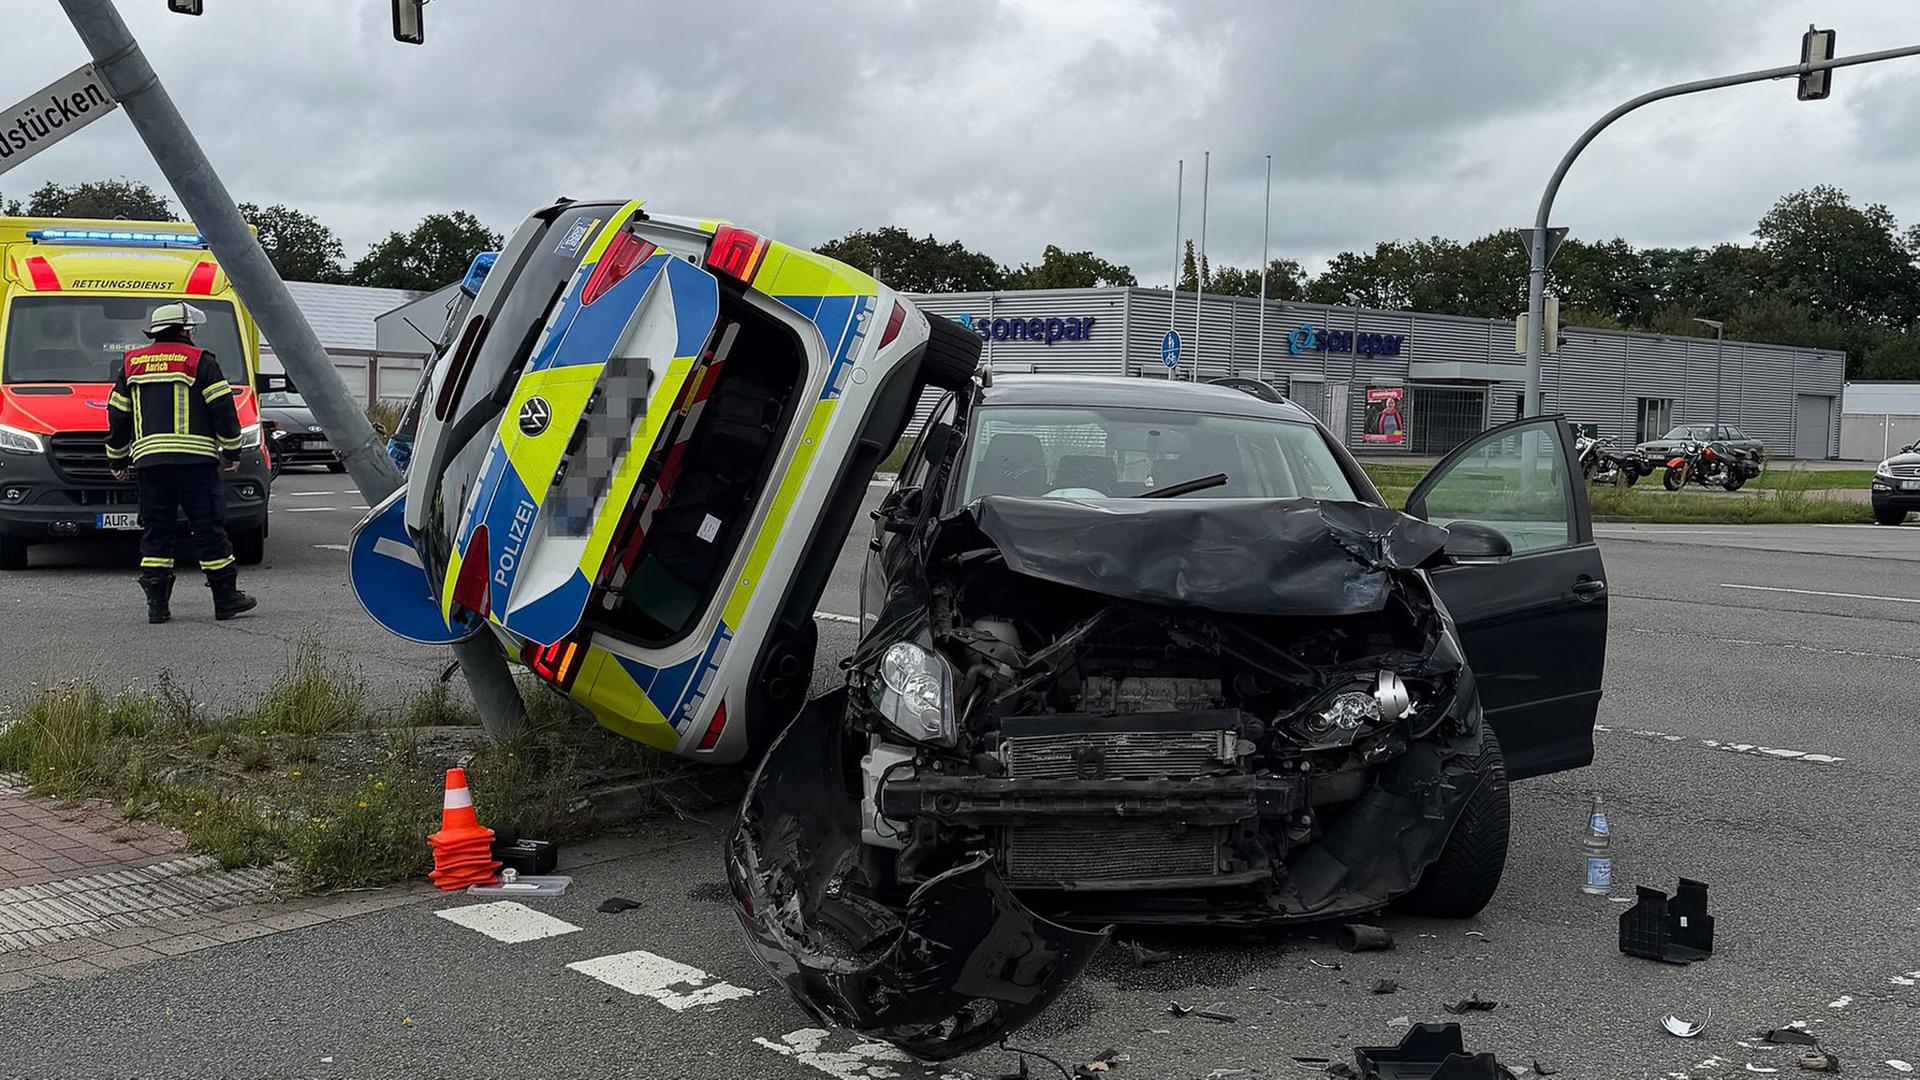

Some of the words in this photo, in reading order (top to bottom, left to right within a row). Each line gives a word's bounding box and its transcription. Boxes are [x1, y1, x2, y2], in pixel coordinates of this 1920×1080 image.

[72, 279, 174, 290] RETTUNGSDIENST
[977, 316, 1096, 346] sonepar
[1316, 328, 1405, 359] sonepar
[145, 361, 169, 373] Aurich
[494, 500, 535, 587] POLIZEI
